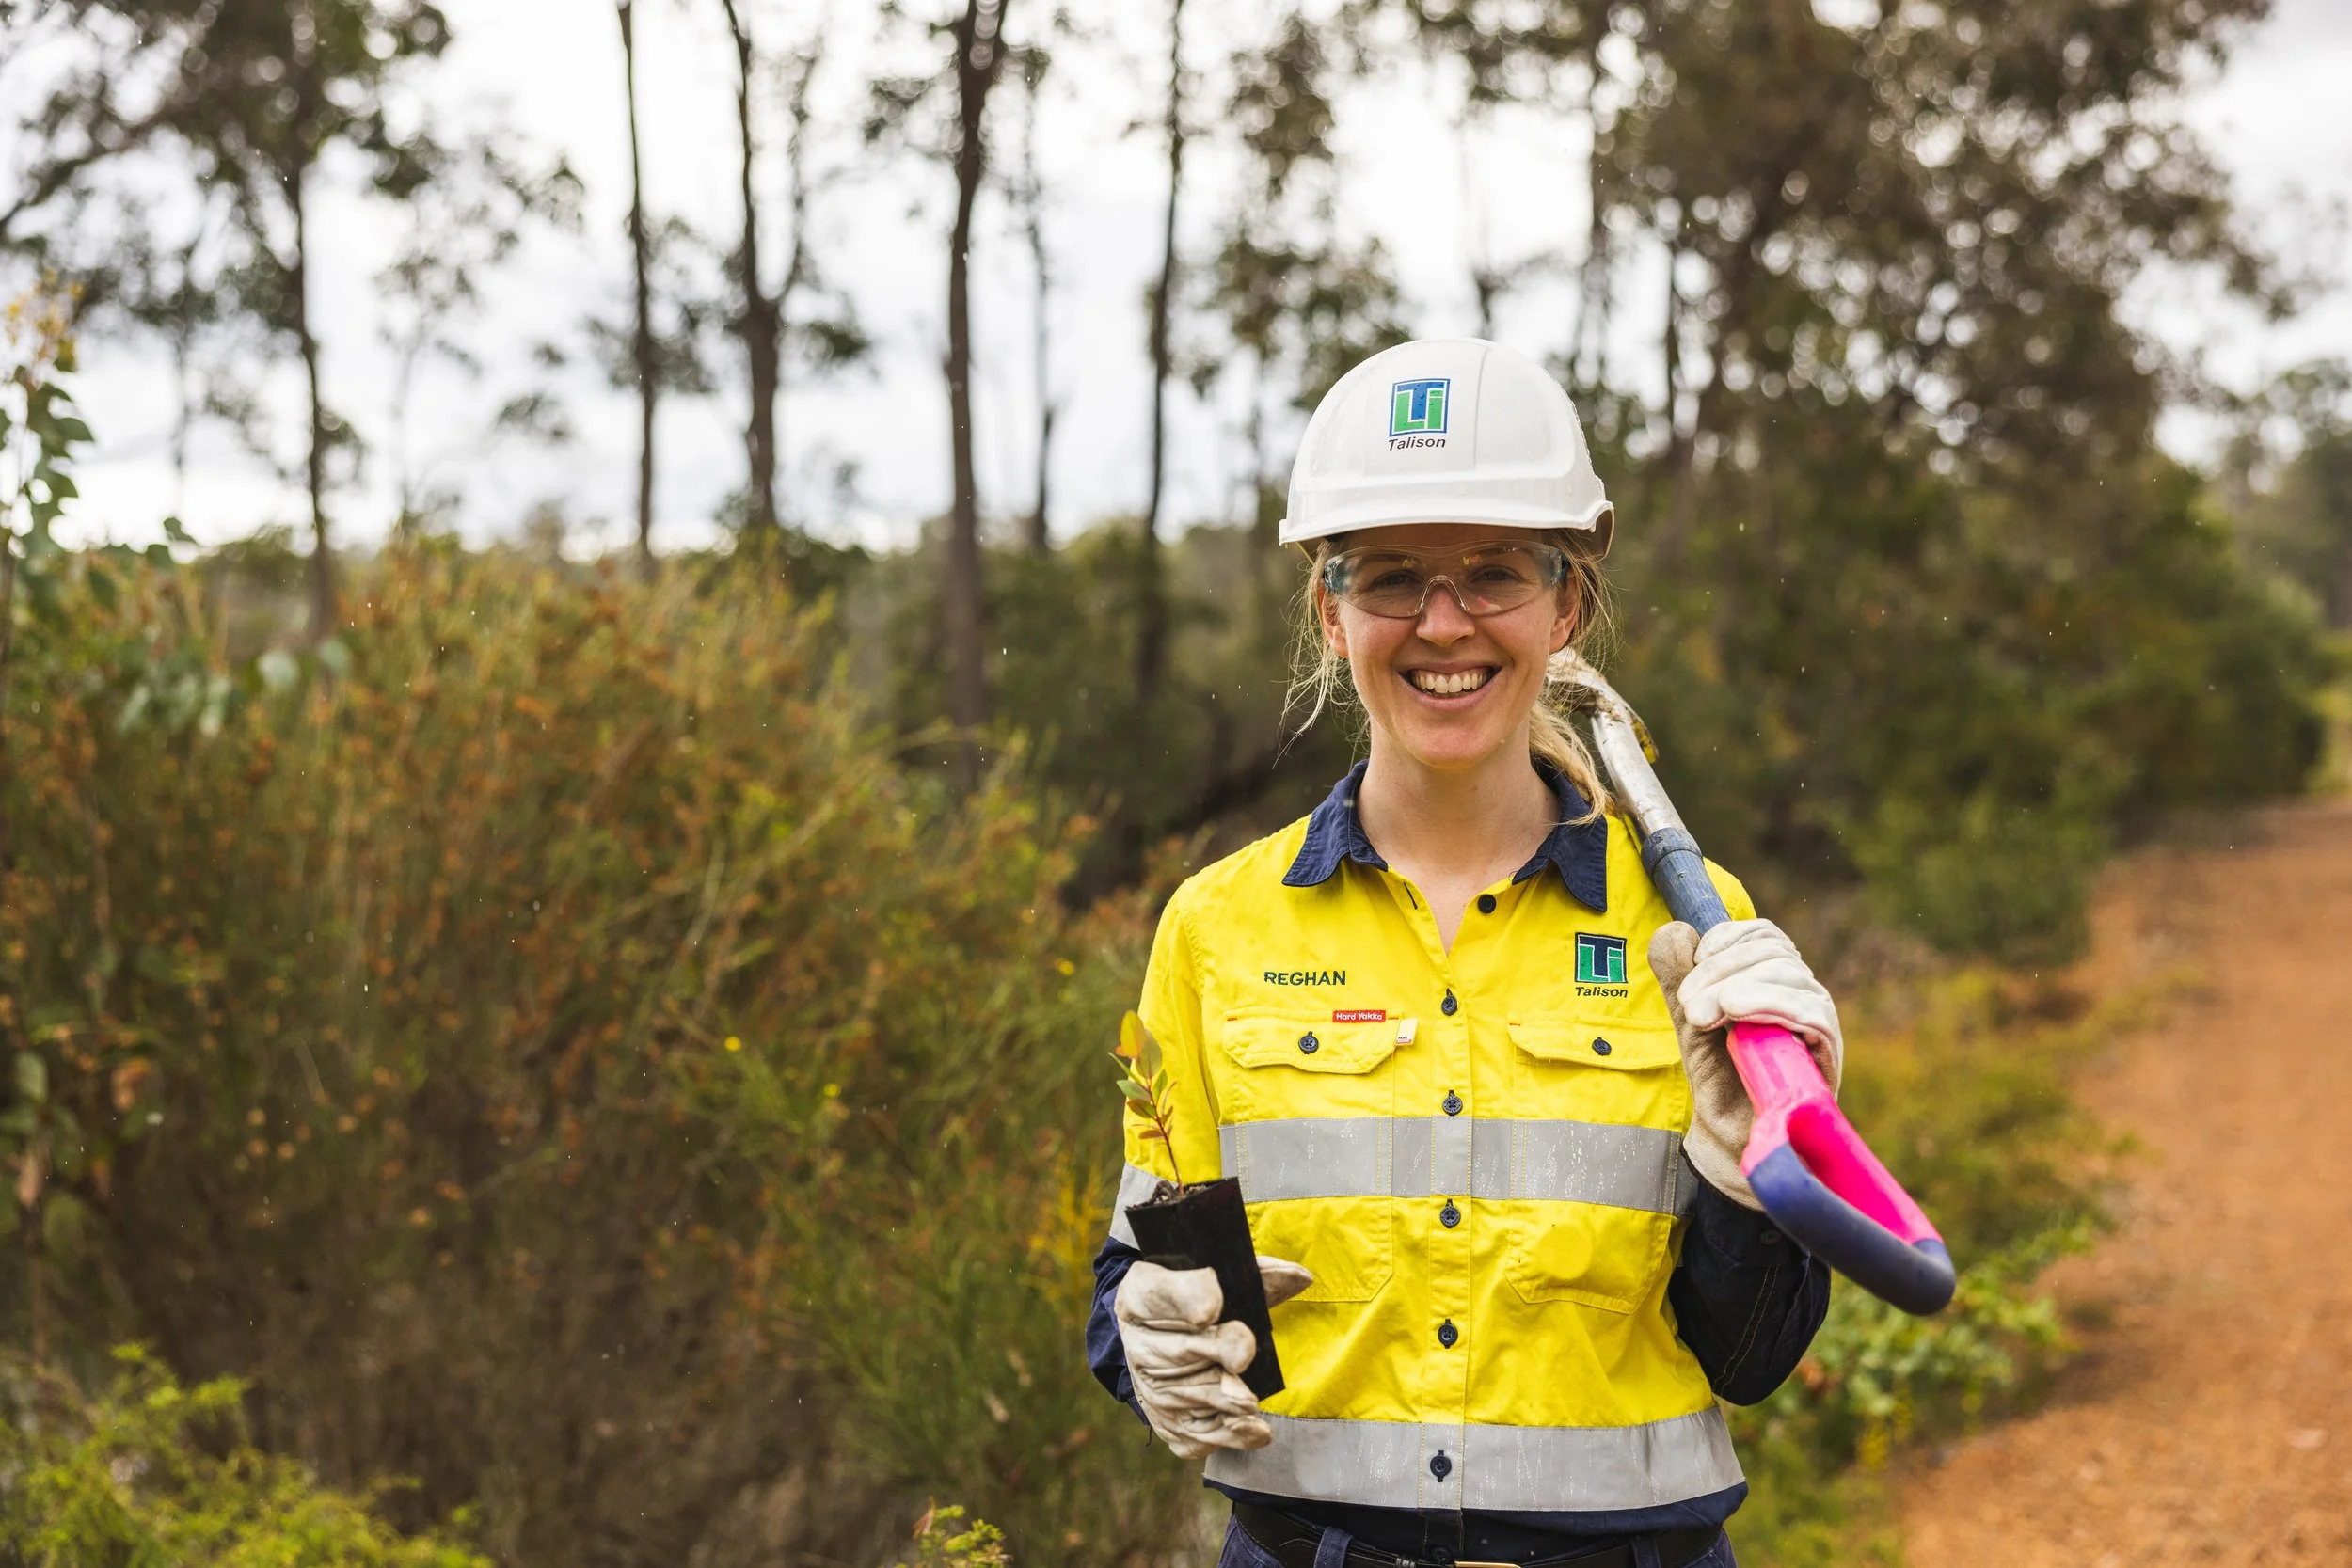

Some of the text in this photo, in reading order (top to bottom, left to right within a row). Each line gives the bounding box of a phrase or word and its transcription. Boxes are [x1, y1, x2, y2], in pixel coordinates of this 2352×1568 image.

[1388, 436, 1446, 451] Talison
[1263, 971, 1346, 986] REGHAN
[1575, 986, 1629, 998] Talison
[1336, 1012, 1383, 1021] Hard Yakka
